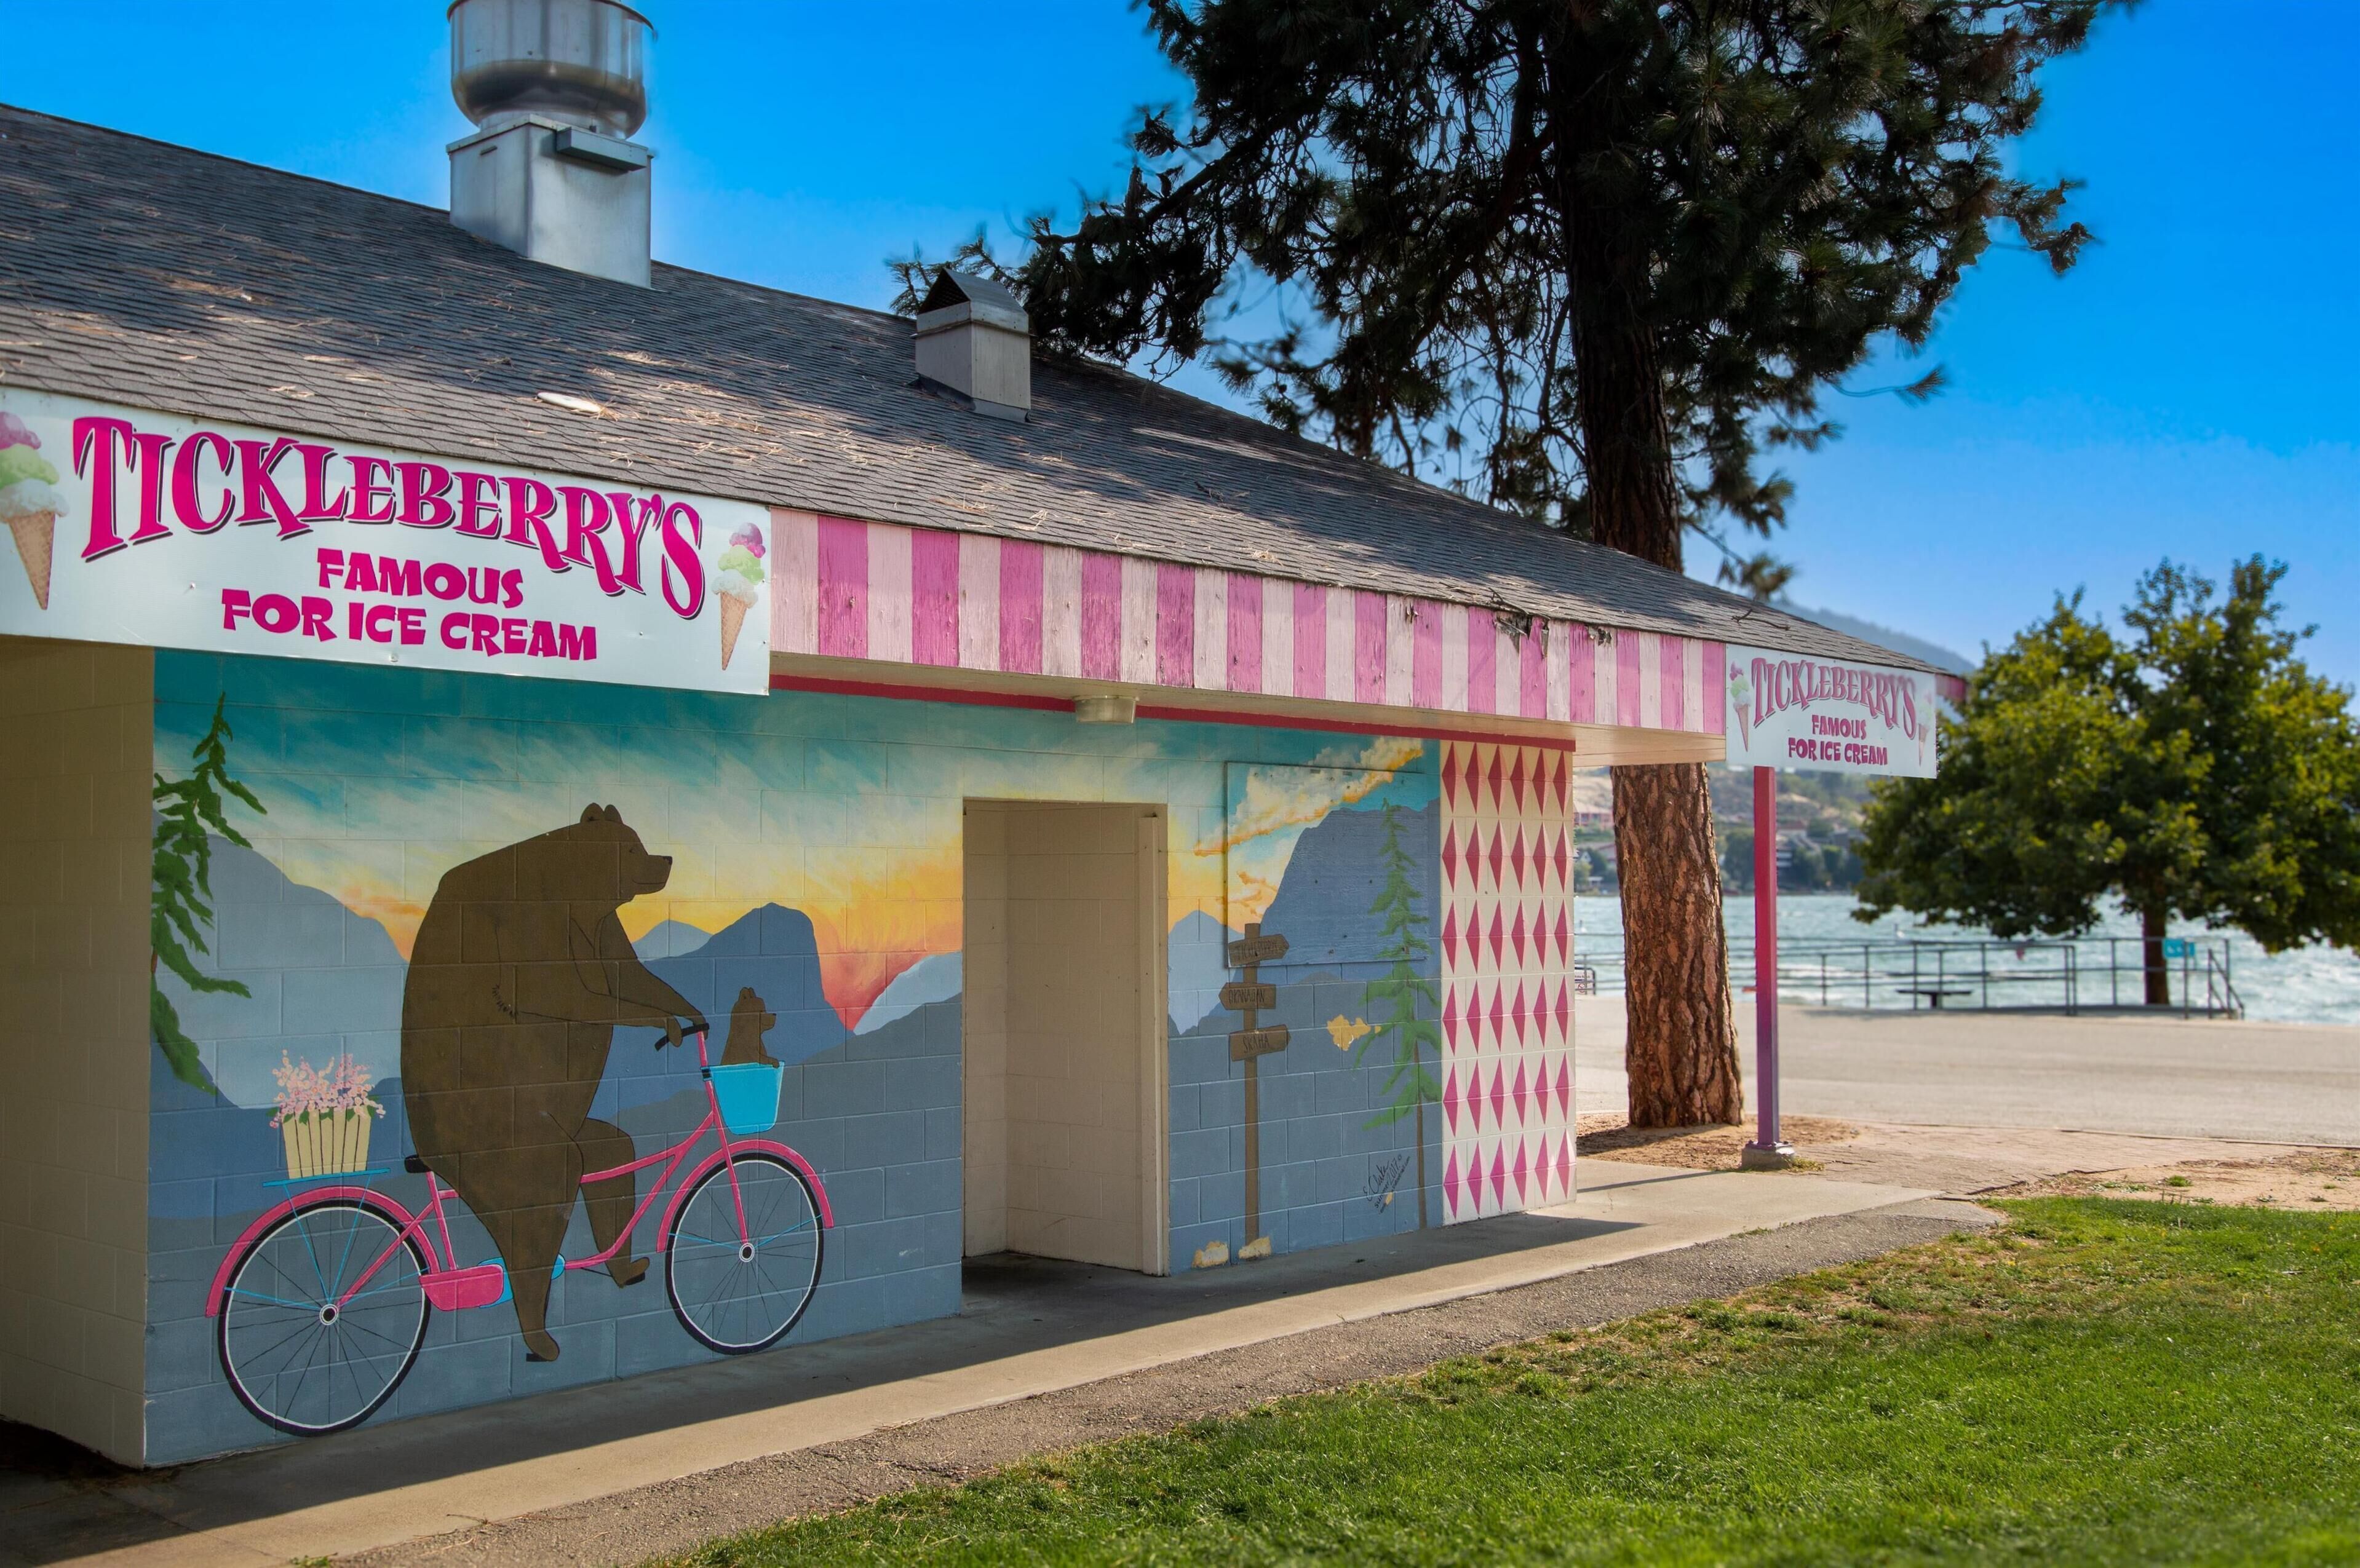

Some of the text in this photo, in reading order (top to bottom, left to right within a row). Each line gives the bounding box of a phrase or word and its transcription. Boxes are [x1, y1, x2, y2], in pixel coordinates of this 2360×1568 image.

[73, 416, 704, 620] TICKLEBERRY'S
[317, 548, 523, 609] FAMOUS
[221, 588, 597, 661] FOR ICE CREAM
[1751, 657, 1917, 740] TICKLEBERRY'S
[1811, 715, 1867, 740] FAMOUS
[1789, 738, 1888, 765] FOR ICE CREAM
[1243, 1032, 1270, 1053] SKAHA
